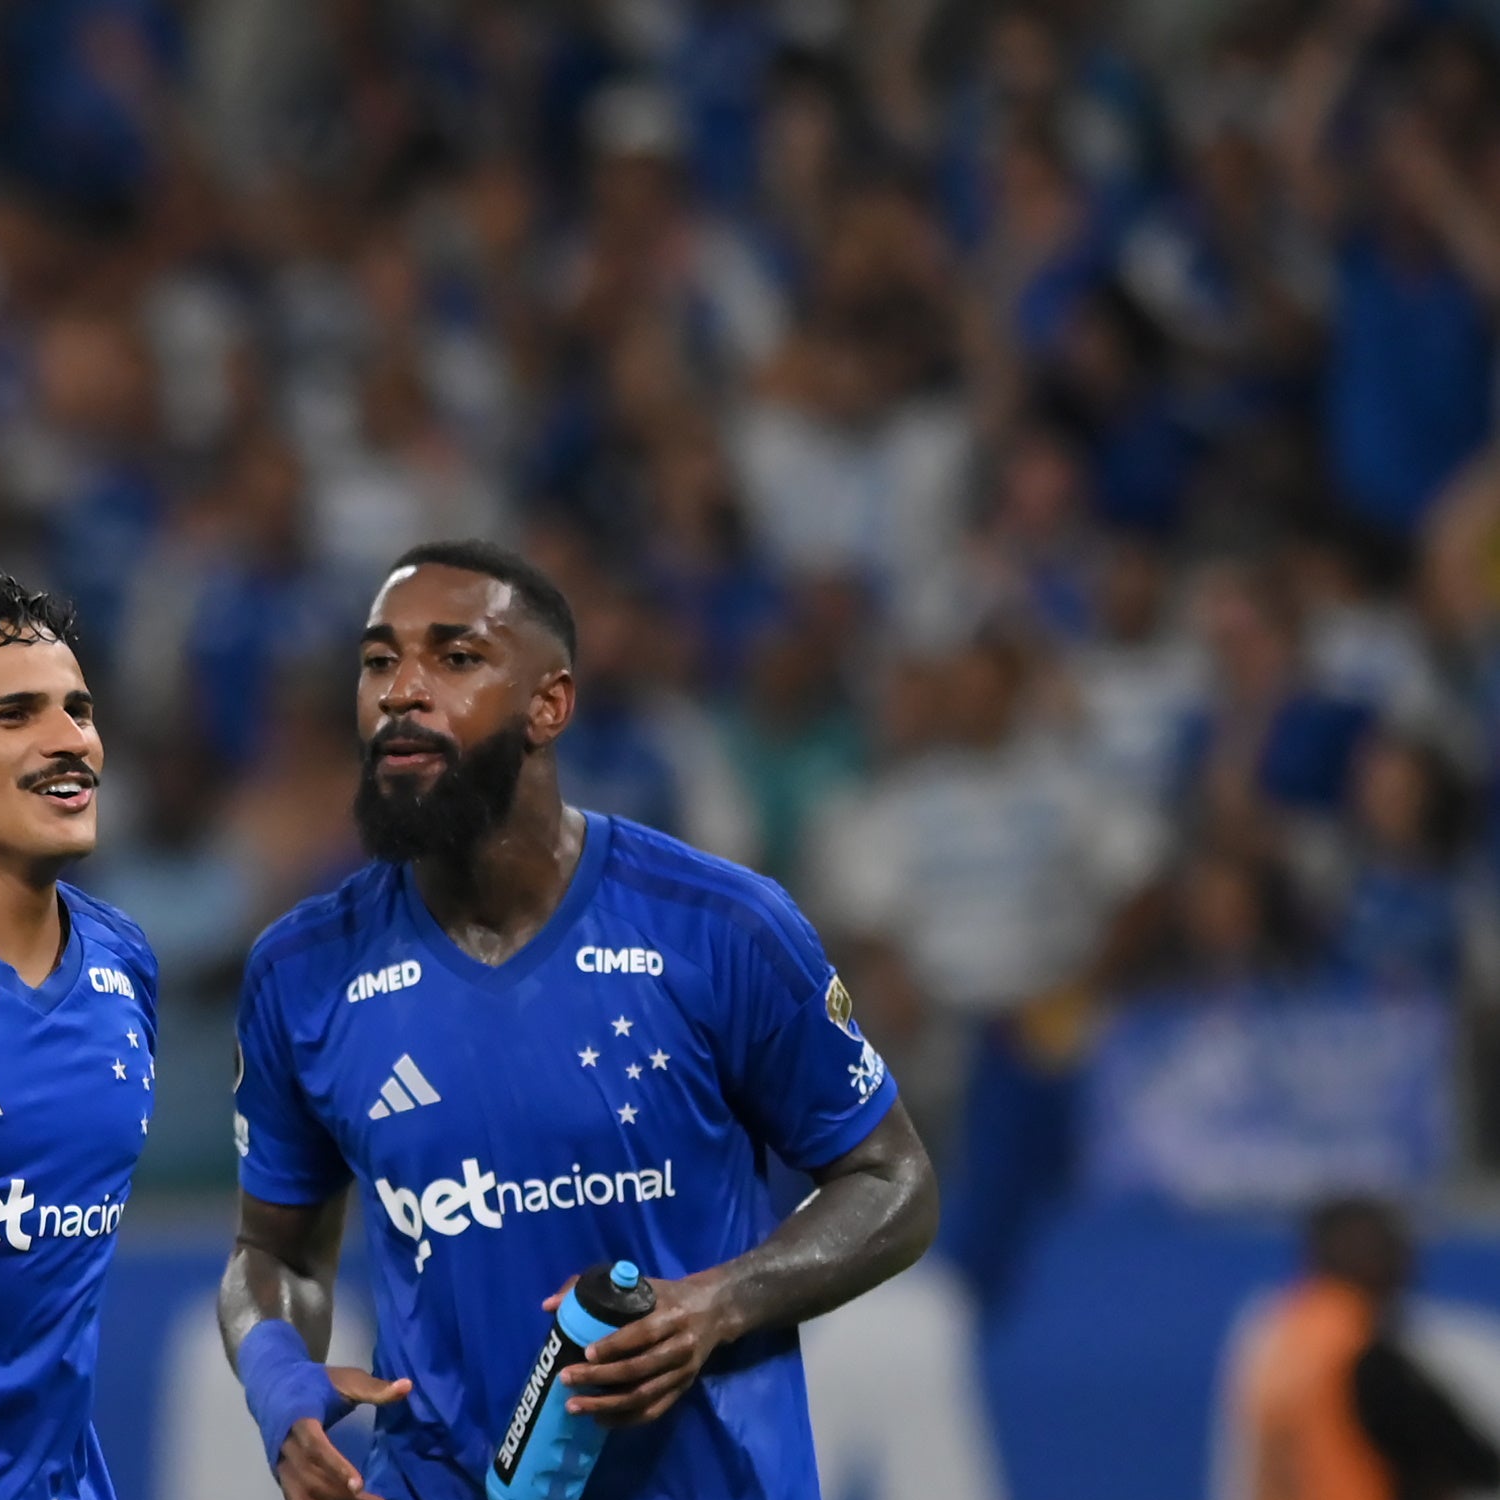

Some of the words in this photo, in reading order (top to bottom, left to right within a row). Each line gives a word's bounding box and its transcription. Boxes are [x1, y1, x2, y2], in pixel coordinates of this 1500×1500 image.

[346, 959, 422, 1003] CIMED
[575, 945, 664, 977] CIMED
[497, 1328, 563, 1471] POWERADE
